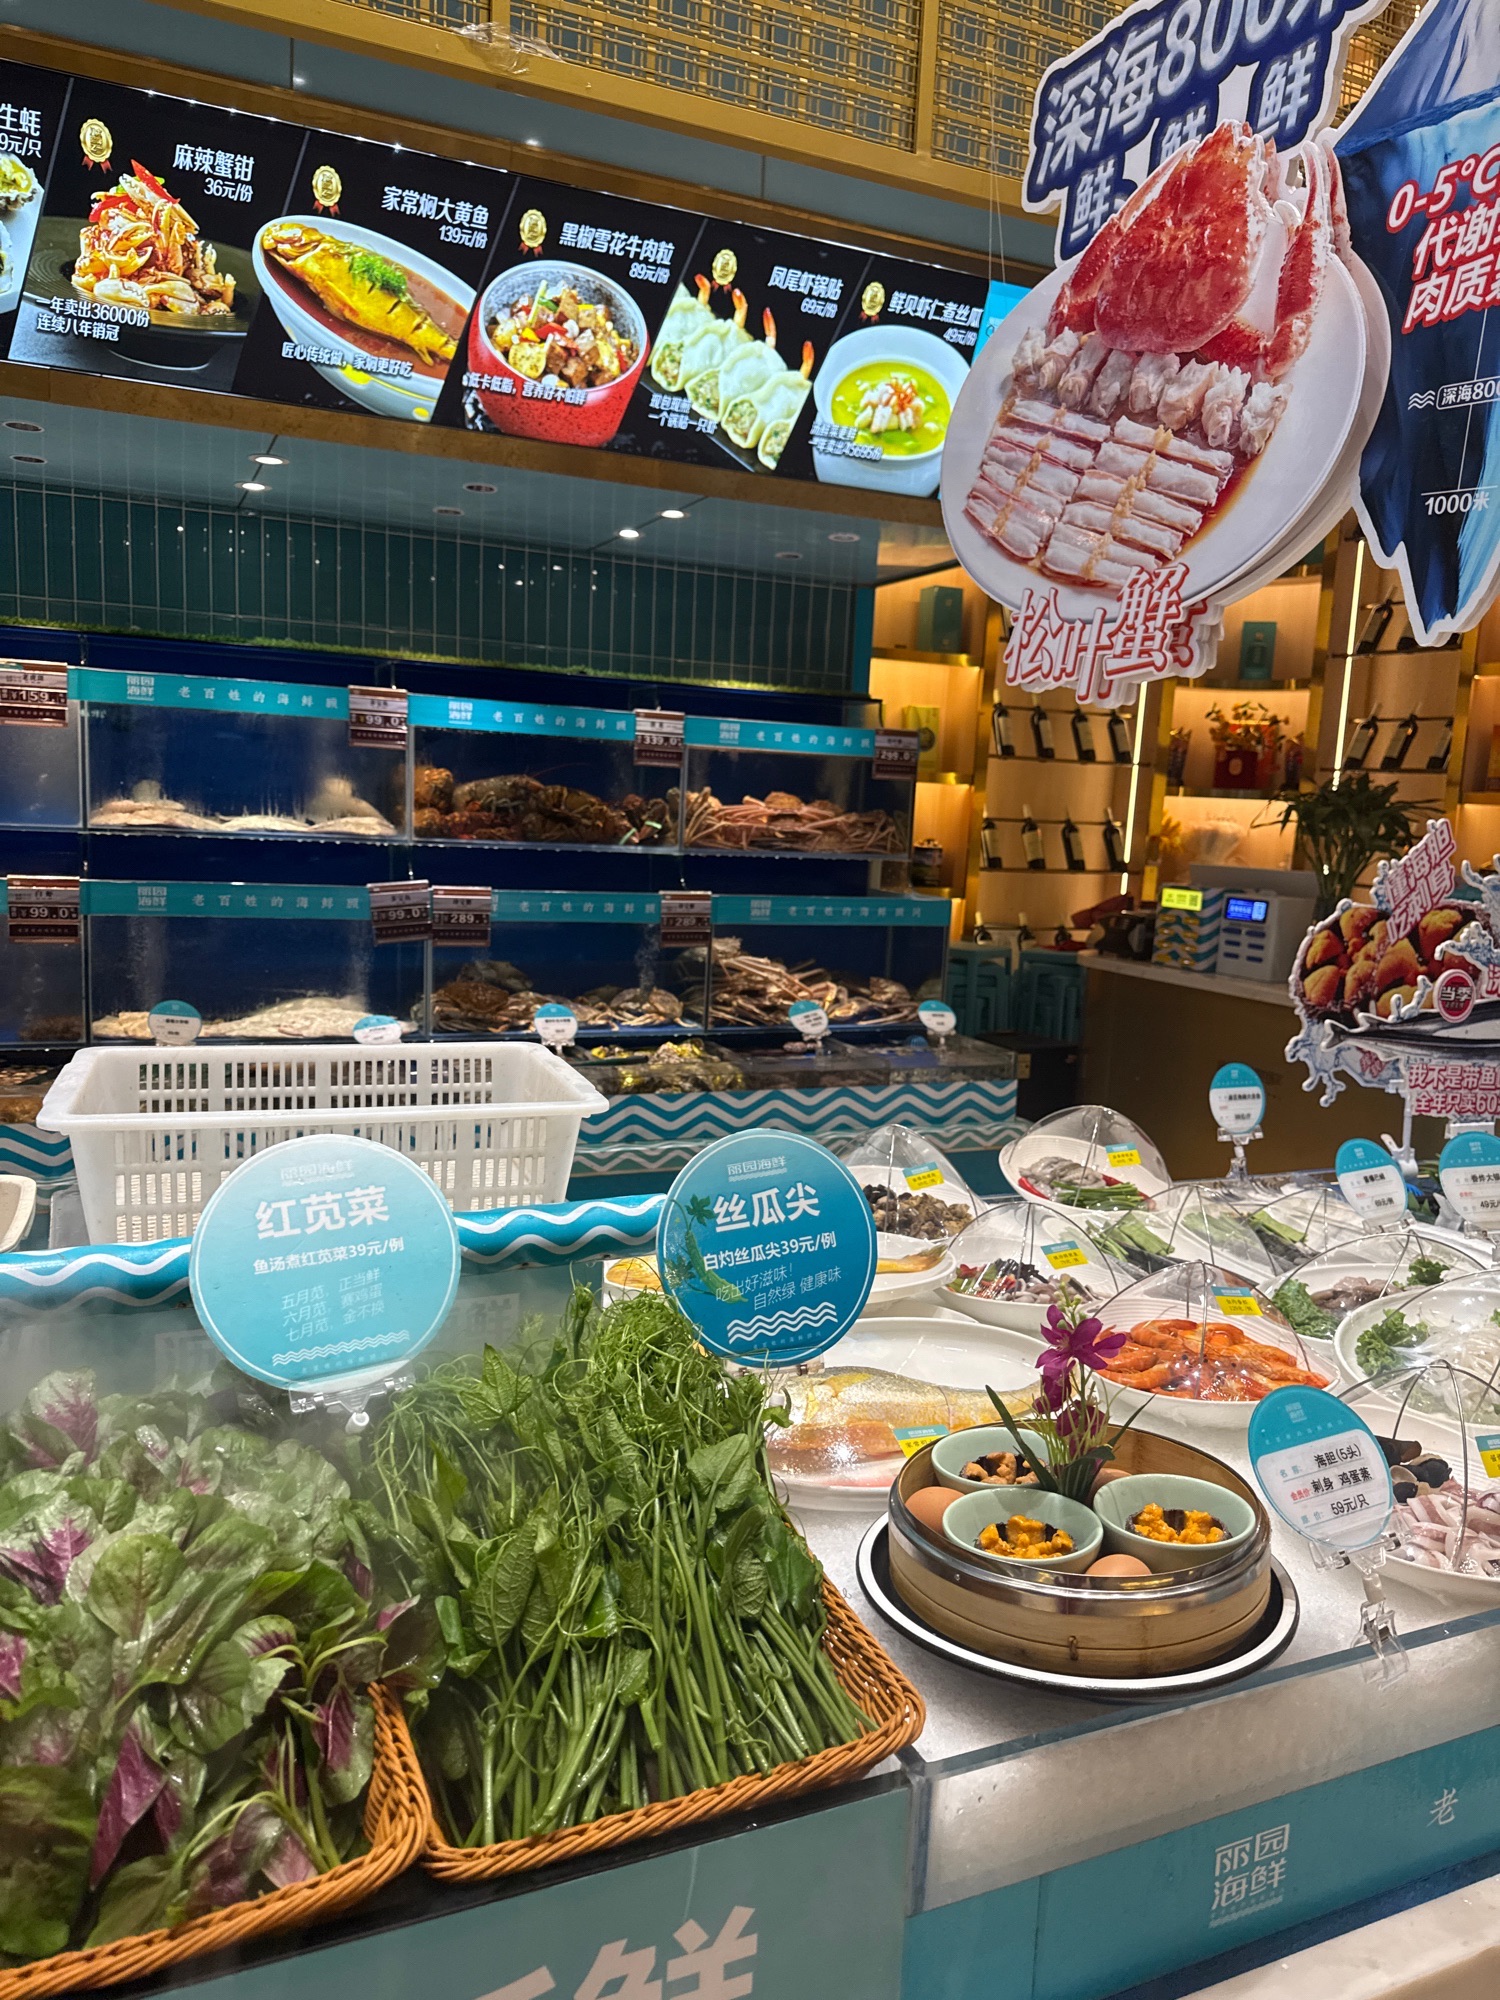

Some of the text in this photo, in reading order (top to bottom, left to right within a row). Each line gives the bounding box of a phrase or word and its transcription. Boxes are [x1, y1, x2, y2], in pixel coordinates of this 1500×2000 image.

[1037, 0, 1333, 185] 深海80
[1258, 41, 1318, 138] 鲜
[0, 103, 41, 137] 生蚝
[172, 143, 255, 181] 麻辣蟹钳
[203, 177, 254, 203] 36元/份
[381, 186, 489, 230] 家常焖大黄鱼
[1069, 158, 1115, 243] 鲜
[438, 225, 488, 249] 139元/份
[559, 221, 675, 265] 黑椒雪花牛肉粒
[1414, 197, 1500, 275] 代谢
[628, 262, 671, 285] 89元/份
[767, 265, 844, 300] 凤尾虾锅贴
[36, 296, 150, 328] 一年卖出36000份
[36, 313, 120, 341] 连续八年销冠
[1424, 490, 1490, 516] 1000米
[1003, 562, 1190, 702] 松叶蟹
[1440, 986, 1472, 1002] 当季
[727, 1156, 787, 1176] 丽园海鲜
[255, 1184, 390, 1240] 红苋菜
[713, 1182, 821, 1233] 丝瓜尖
[253, 1236, 405, 1276] 鱼汤煮红苋菜39元/例
[703, 1231, 837, 1272] 白灼丝瓜尖39元/例
[754, 1265, 842, 1311] 自然绿 健康味
[1313, 1443, 1363, 1469] 海胆(5头)
[1310, 1476, 1334, 1494] 刺身
[1330, 1493, 1370, 1516] 59元/只
[1427, 1788, 1459, 1828] 老
[1214, 1823, 1290, 1877] 丽园
[1210, 1857, 1287, 1911] 海鲜
